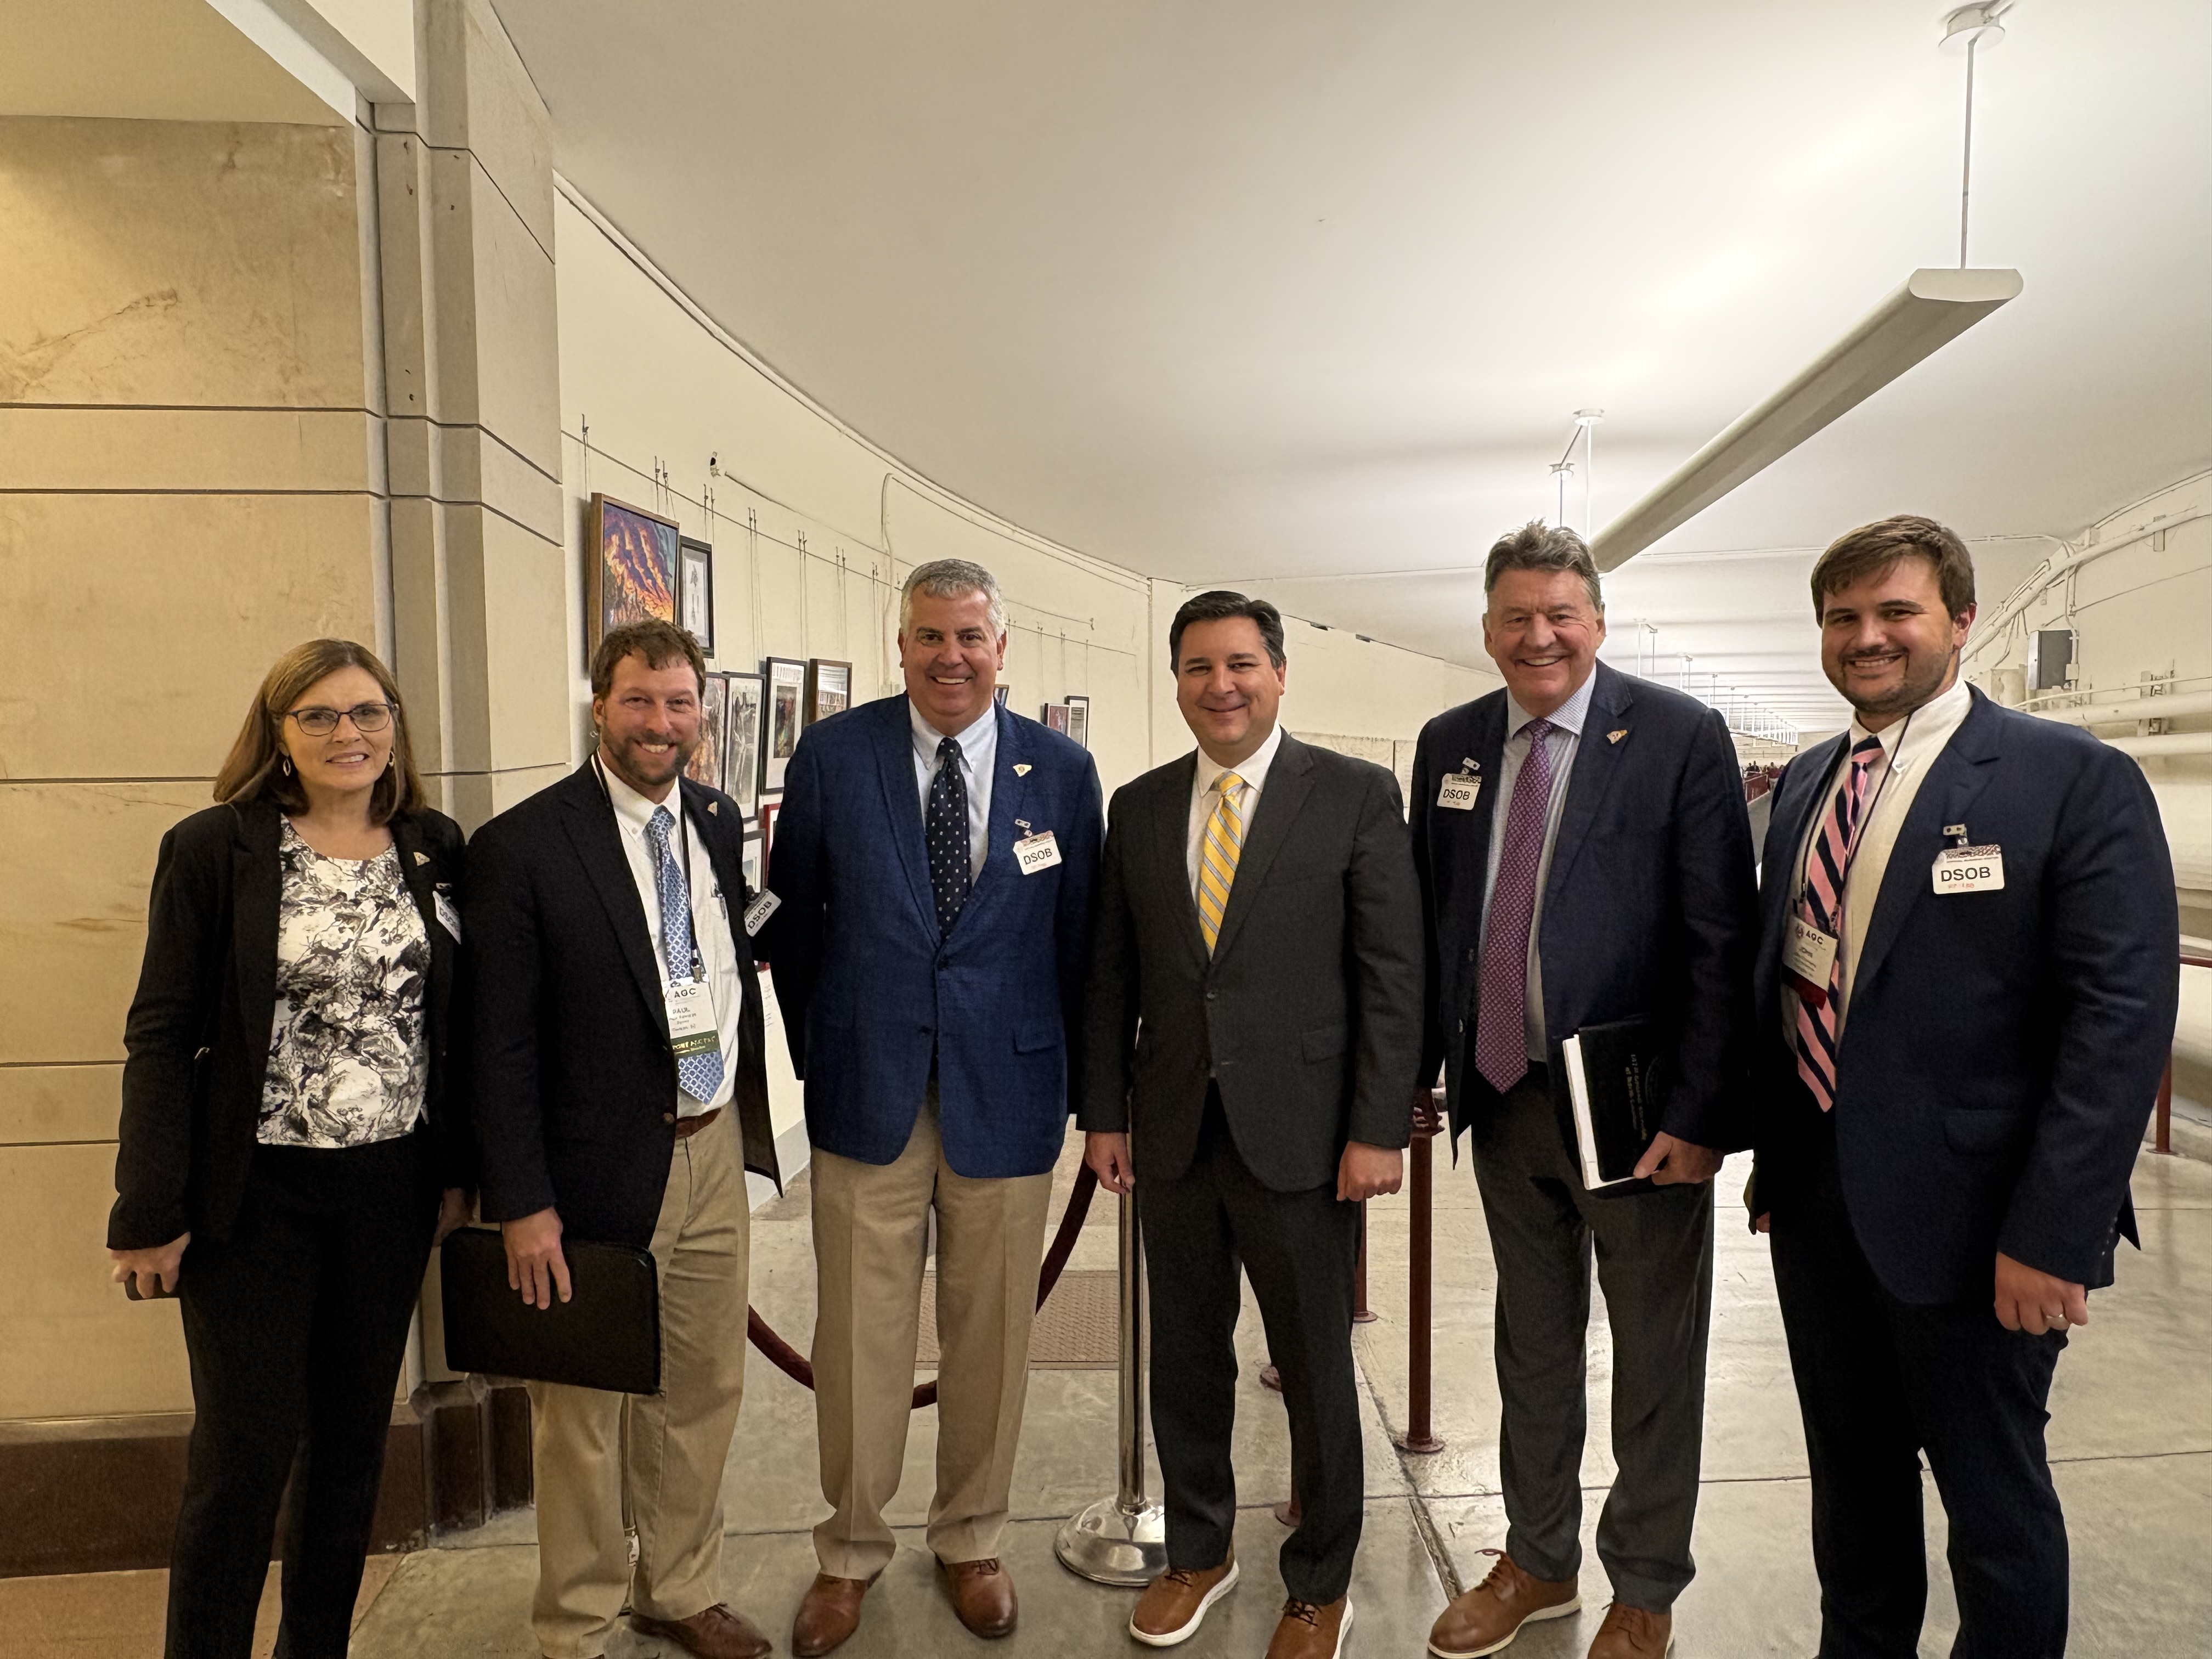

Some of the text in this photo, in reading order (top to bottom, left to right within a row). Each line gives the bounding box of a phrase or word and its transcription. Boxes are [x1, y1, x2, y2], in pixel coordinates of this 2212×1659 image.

[1443, 789, 1470, 800] DSOB
[1023, 848, 1052, 865] DSOB
[1940, 866, 1991, 882] DSOB
[747, 901, 772, 929] DSOB
